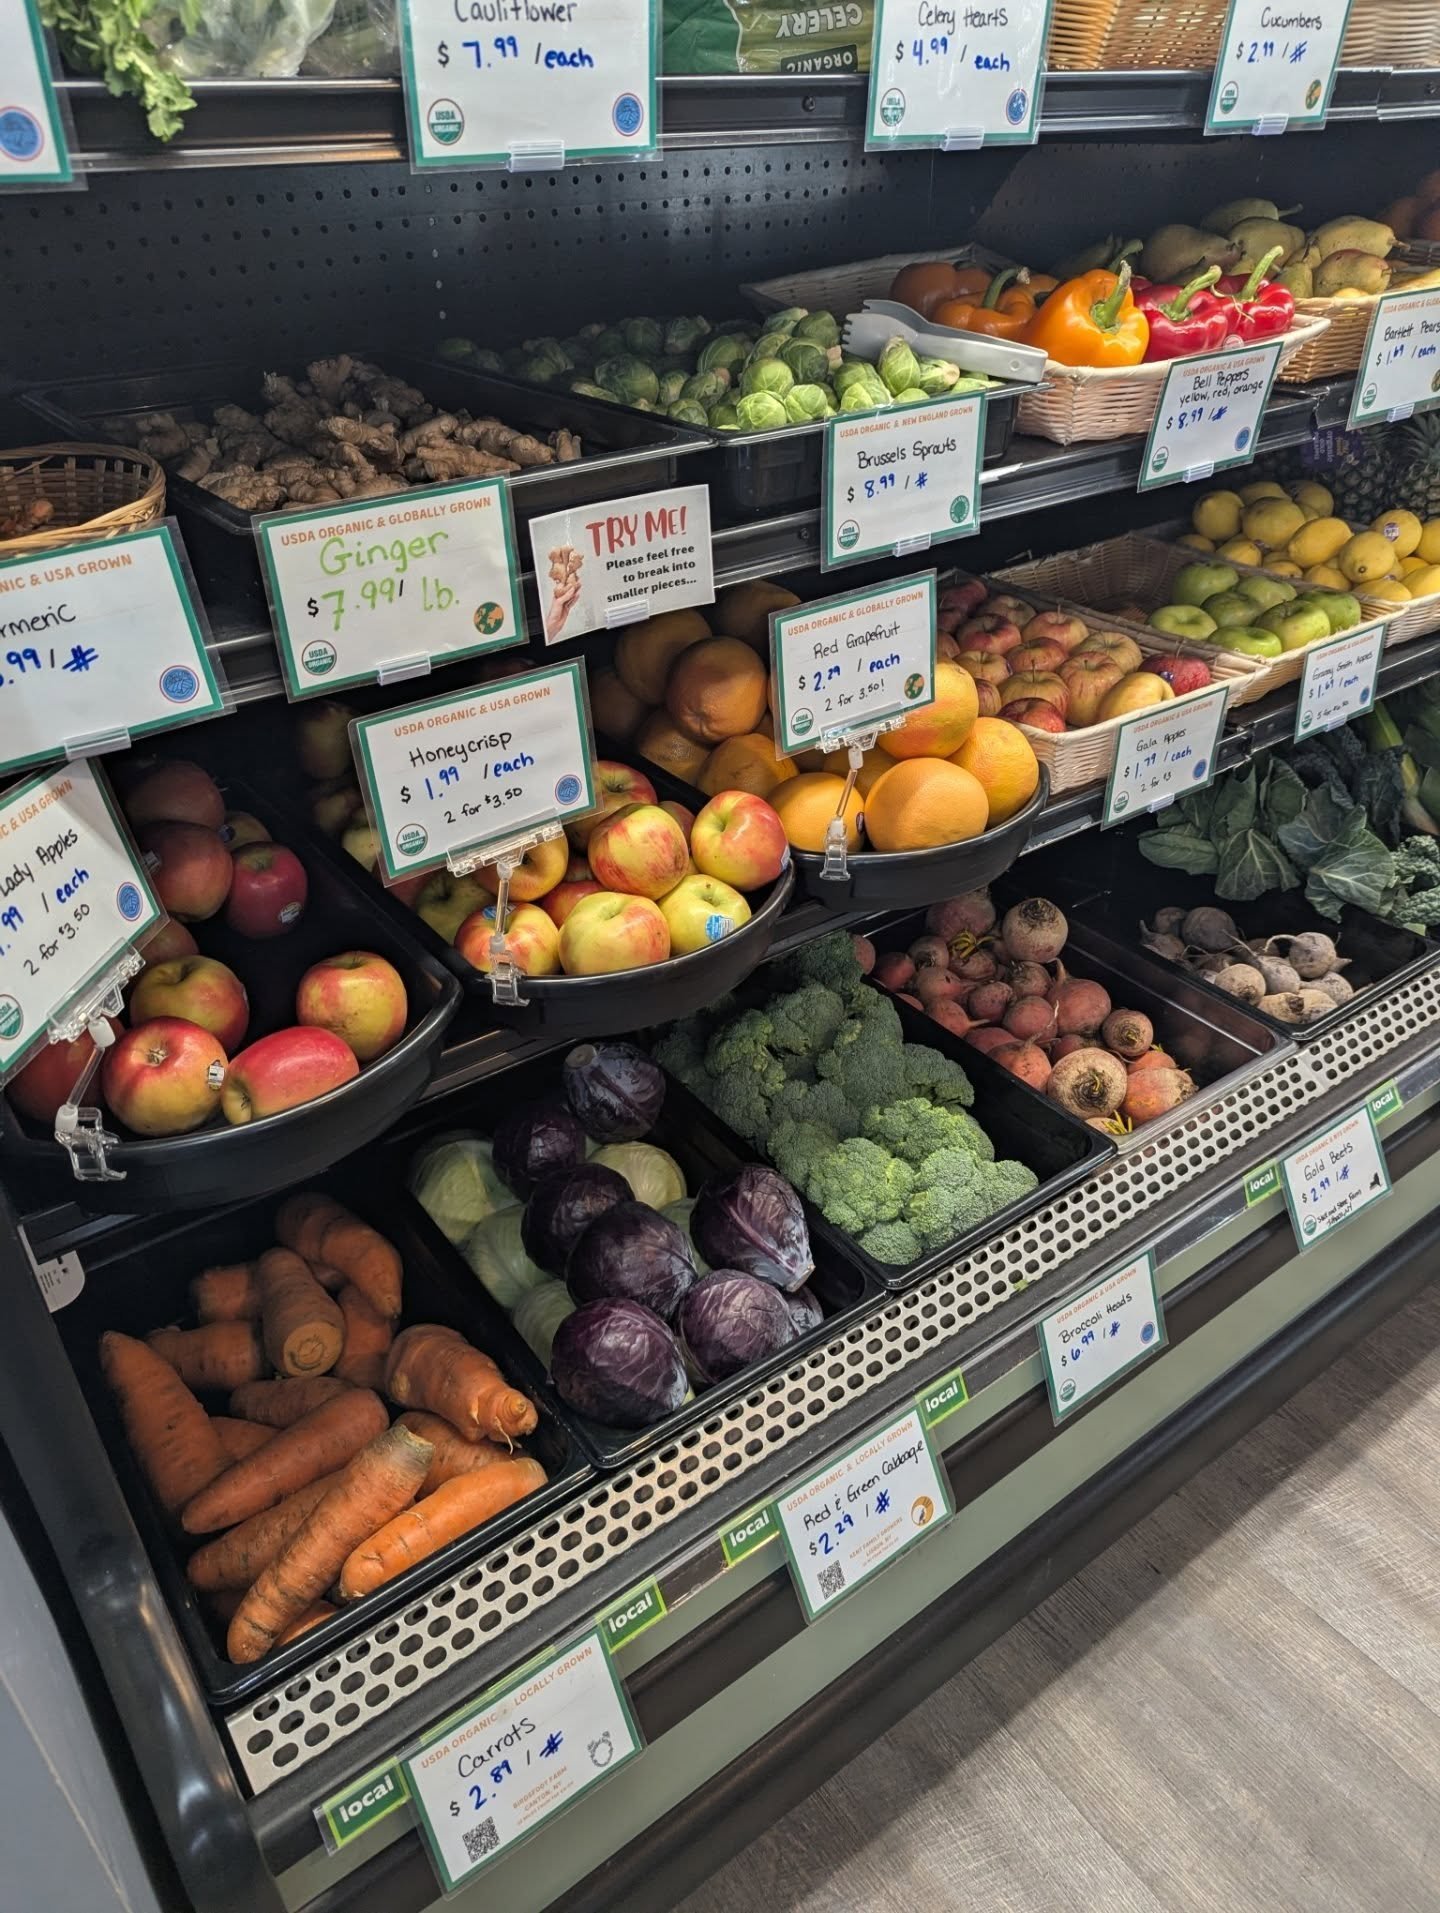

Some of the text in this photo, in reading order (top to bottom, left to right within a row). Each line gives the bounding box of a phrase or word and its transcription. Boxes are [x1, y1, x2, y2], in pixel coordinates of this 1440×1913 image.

[454, 0, 578, 22] Cauliflower
[775, 3, 863, 38] CELERY
[918, 1, 1008, 35] Celery Hearts
[1261, 6, 1322, 30] Cucumbers
[462, 36, 519, 68] 7.99
[786, 51, 853, 72] ORGANIC
[912, 36, 1010, 72] 4.99 each
[435, 111, 456, 121] USDA
[1183, 355, 1265, 377] USDA ORGANIC USA GROWN
[1193, 368, 1250, 390] Bell Peppers
[1233, 380, 1264, 395] orange
[840, 406, 973, 438] USDA ORGANIC NEW ENGLAND GROWN
[1178, 407, 1203, 429] 8.99
[857, 437, 957, 469] Brussels Sprouts
[864, 473, 896, 498] 8.99
[281, 497, 491, 546] USDA ORGANIC GLOBALLY GROWN
[585, 506, 687, 557] TRY ME!
[44, 565, 75, 583] USA
[78, 554, 133, 576] GROWN
[320, 531, 449, 575] Ginger
[606, 544, 695, 571] Please feel free
[623, 560, 696, 583] to break into
[422, 576, 460, 612] lb.
[607, 579, 697, 603] smaller pieces...
[788, 591, 923, 636] USDA ORGANIC GLOBALLY GROWN
[308, 648, 328, 658] USDA
[813, 621, 900, 660] Red Grapefruit
[306, 658, 333, 669] ORGANIC
[813, 653, 900, 692] 2.29 each
[394, 687, 551, 737] USDA ORGANIC USA GROWN
[838, 694, 853, 707] for
[1133, 724, 1149, 733] USDA
[1150, 715, 1175, 729] ORGANIC
[1194, 701, 1213, 712] GROWN
[409, 731, 512, 768] Honeycrisp
[1136, 729, 1187, 752] Gala Apples
[1135, 745, 1191, 779] 1.79 each
[425, 766, 460, 800] 1.99
[1150, 777, 1159, 788] for
[18, 780, 73, 823] USA GROWN
[444, 787, 522, 824] 2 for $3.50
[35, 829, 78, 866] Apples
[401, 838, 425, 850] ORGANIC
[402, 831, 420, 841] USDA
[55, 868, 89, 904] each
[24, 959, 39, 976] 2
[39, 940, 59, 960] for
[1373, 1089, 1394, 1111] local
[1304, 1142, 1353, 1181] Gold Beets
[1250, 1169, 1274, 1192] local
[1311, 1177, 1330, 1202] 2.99
[1056, 1268, 1137, 1324] USDA ORGANIC USA GROWN
[1058, 1292, 1132, 1344] Broccoli Heads
[1071, 1330, 1095, 1360] 6.99
[925, 1381, 958, 1413] local
[786, 1420, 913, 1511] USDA ORGANIC LOCALLY GROWN
[803, 1440, 924, 1530] Red Green Cabbage
[728, 1510, 770, 1547] local
[608, 1592, 653, 1633] local
[421, 1646, 593, 1769] USDA ORGANIC LOCALLY GROWN
[458, 1717, 536, 1778] Carrots
[339, 1774, 394, 1823] local
[469, 1760, 513, 1810] 2.89
[512, 1777, 548, 1809] BIRDSFOOT
[548, 1766, 568, 1783] FARM
